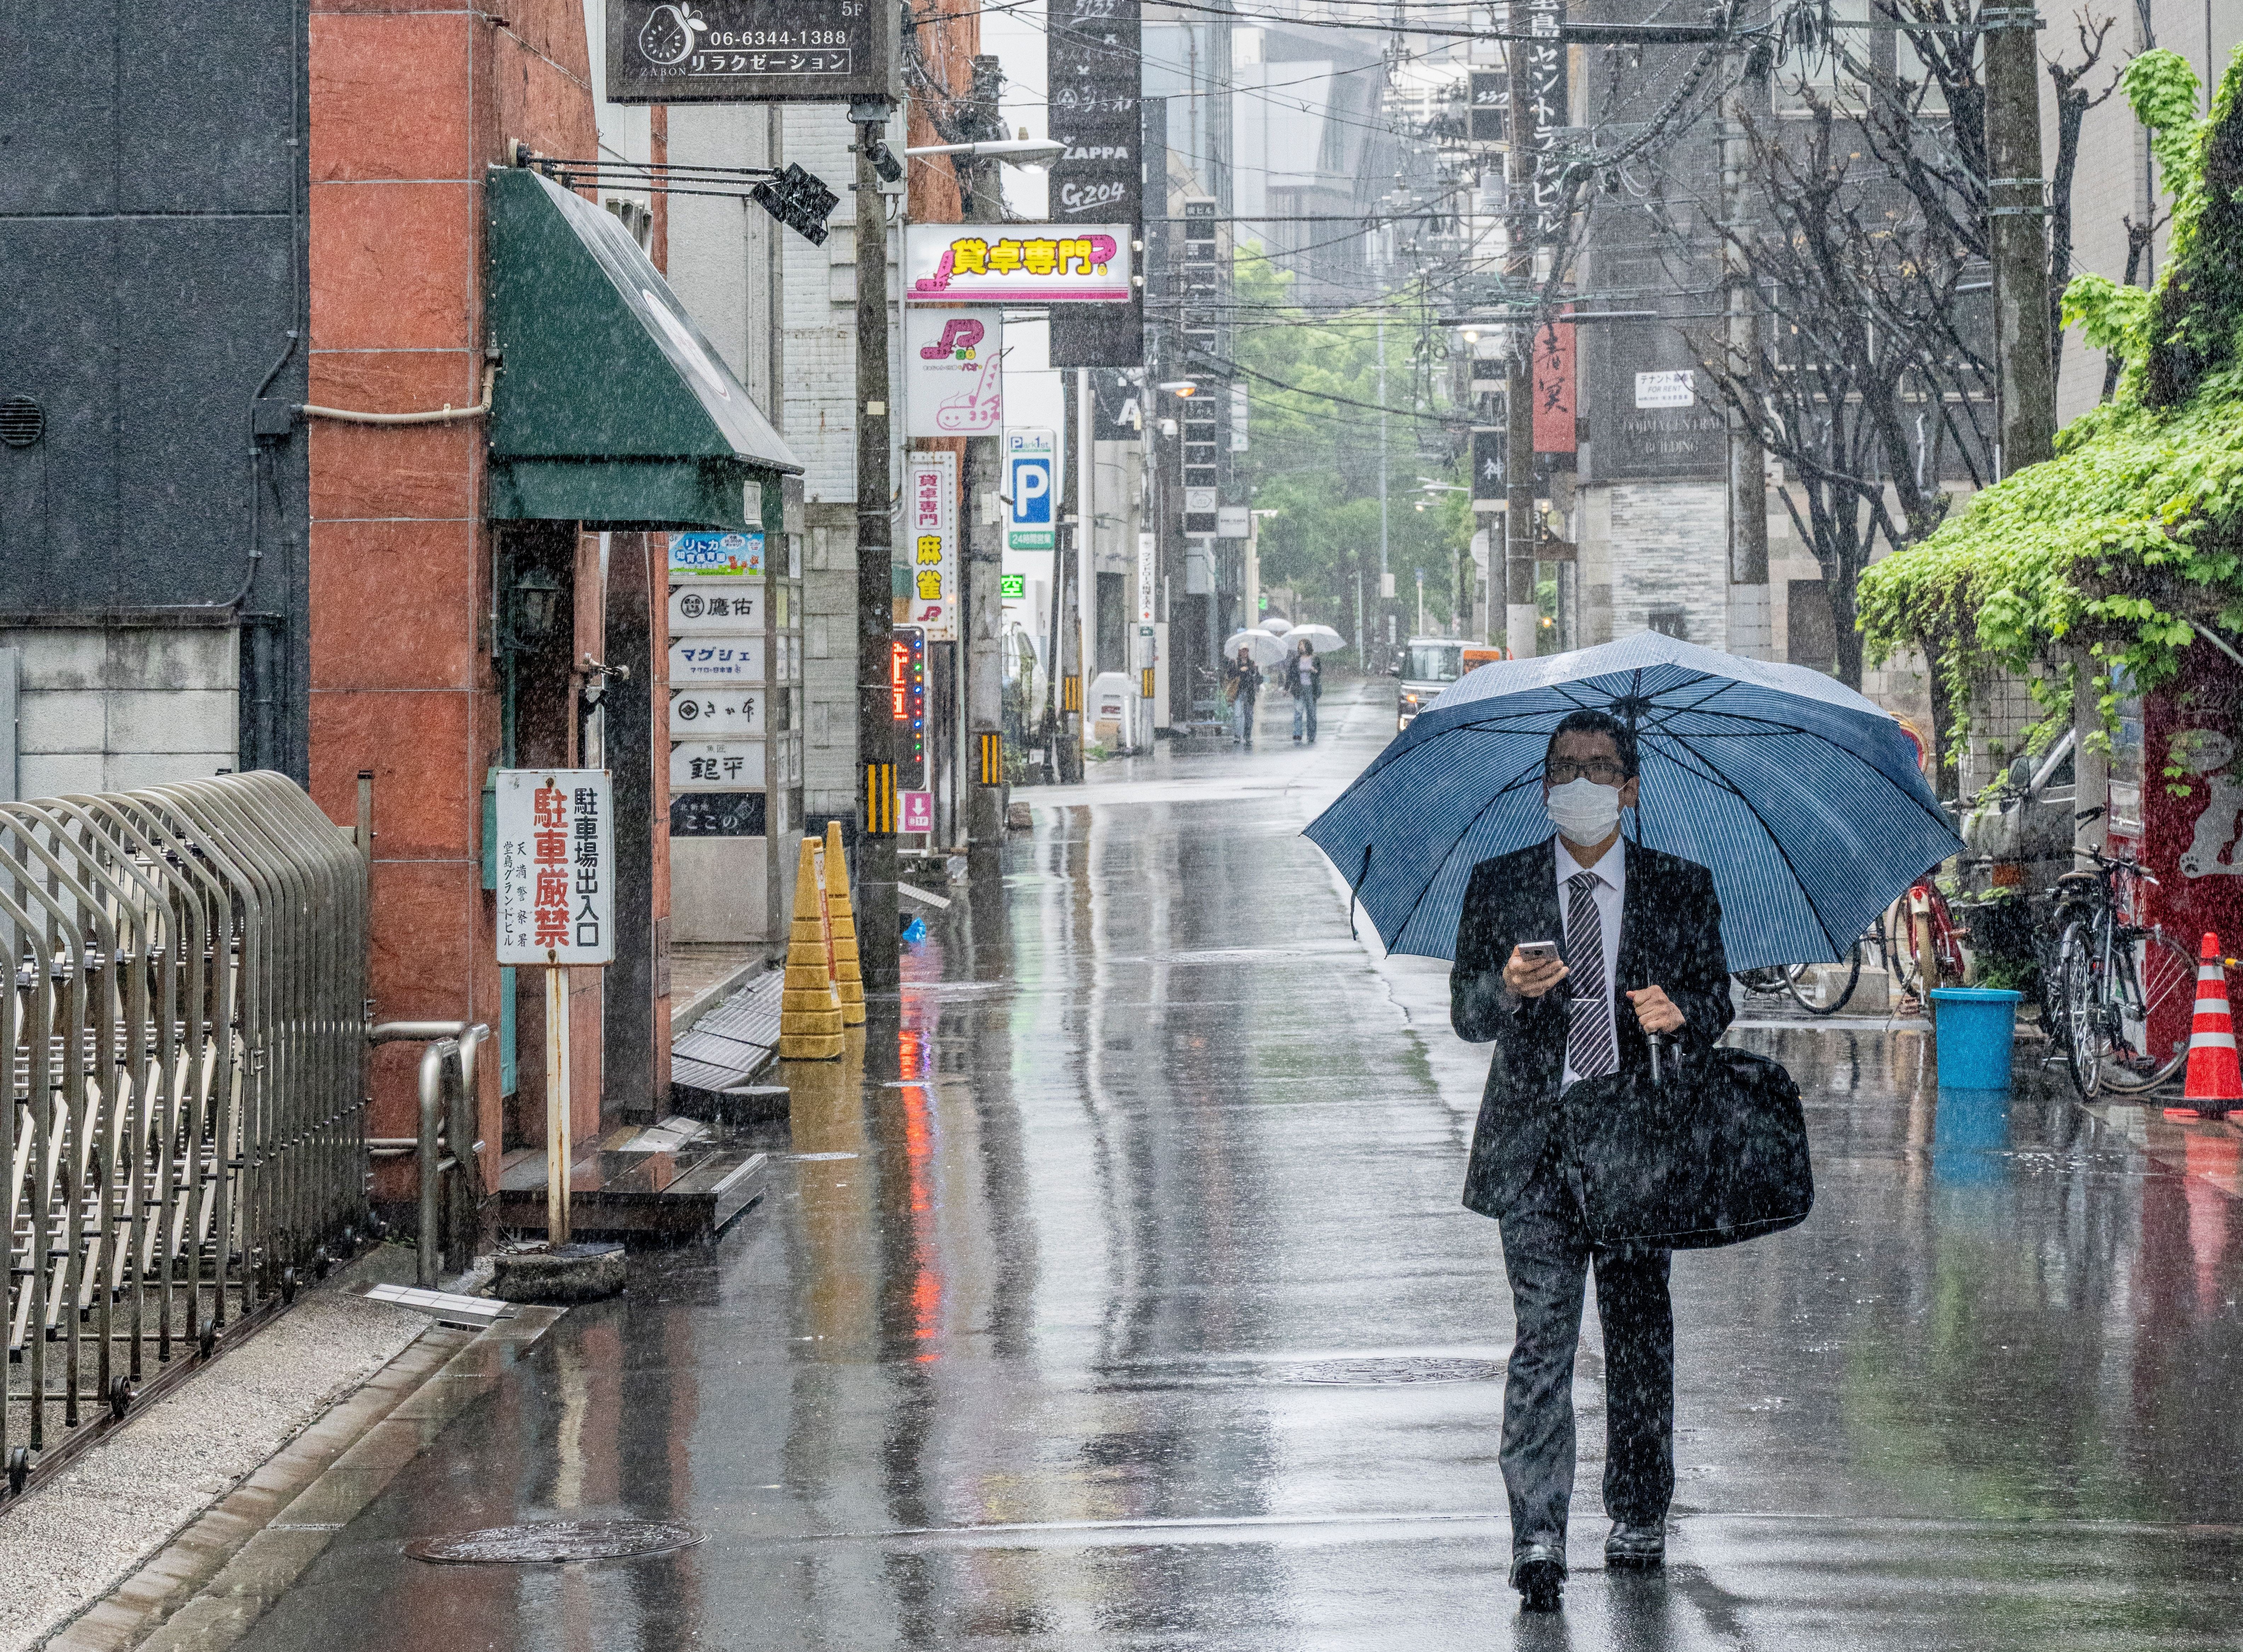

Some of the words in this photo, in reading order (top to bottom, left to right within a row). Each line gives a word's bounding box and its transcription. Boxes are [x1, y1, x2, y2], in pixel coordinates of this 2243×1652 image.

[711, 30, 846, 46] 06-6344-1388
[641, 67, 687, 76] ZABON
[692, 54, 845, 71] リラクゼーション
[1062, 147, 1129, 159] ZAPPA
[1062, 182, 1126, 207] G204
[951, 237, 1093, 275] 貸卓専門
[919, 474, 938, 526] 貸卓専門
[685, 539, 719, 552] リトカ
[916, 535, 942, 600] 麻雀
[1001, 575, 1023, 597] 空
[533, 787, 570, 948] 駐車厳禁
[574, 787, 599, 947] 駐車場出入口
[503, 841, 513, 947] 堂島グランドビル
[515, 841, 528, 947] 天満警察署
